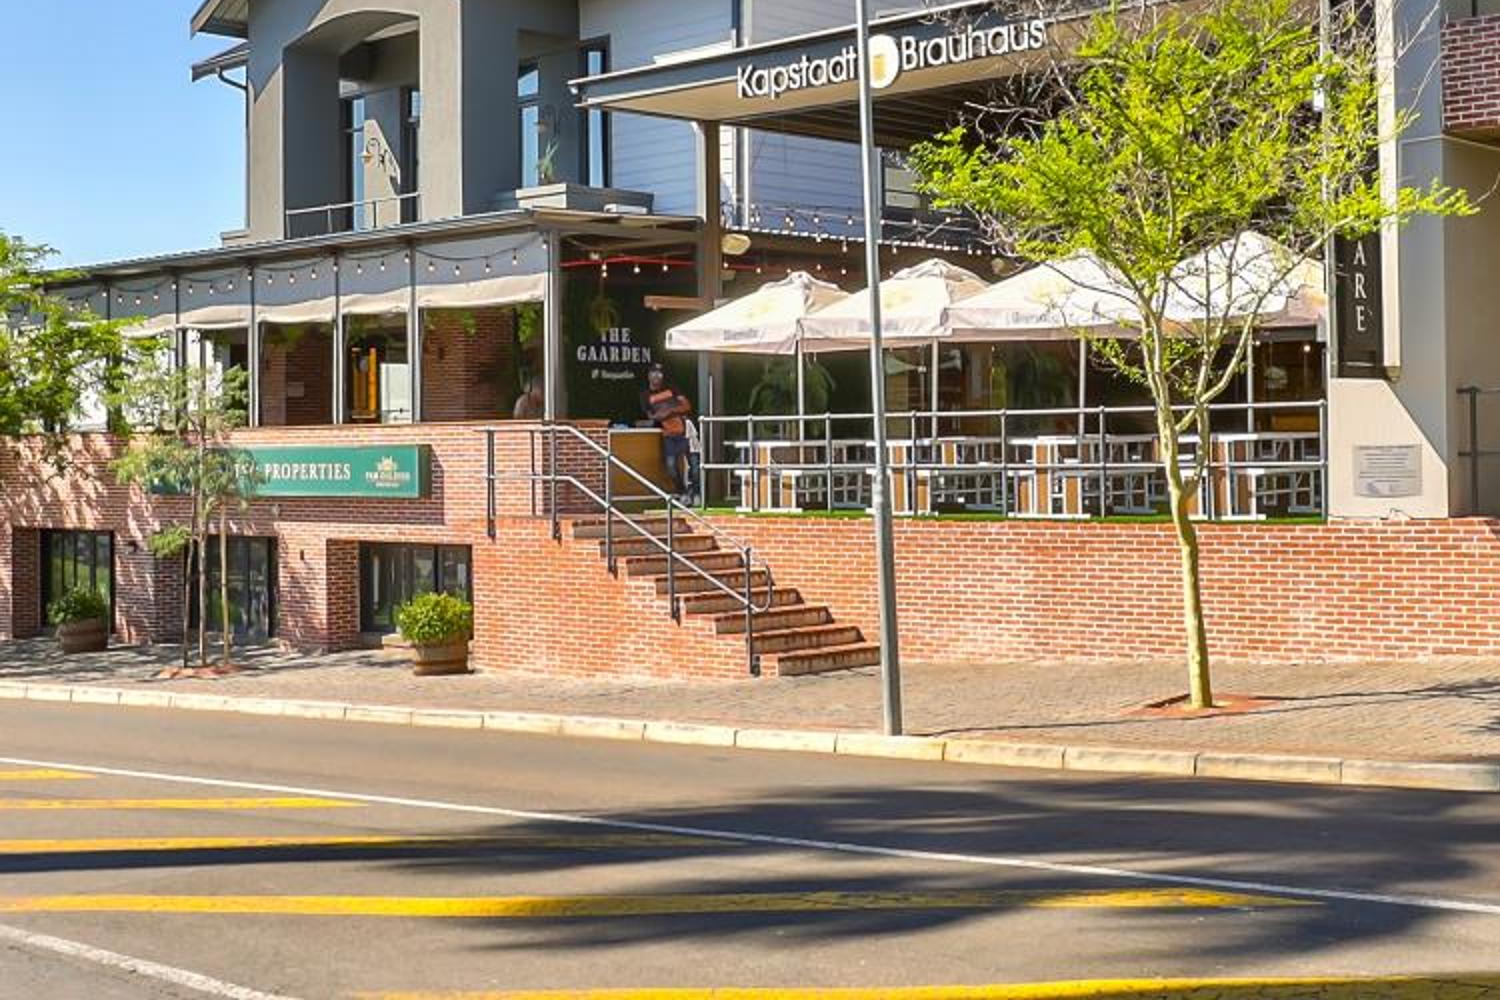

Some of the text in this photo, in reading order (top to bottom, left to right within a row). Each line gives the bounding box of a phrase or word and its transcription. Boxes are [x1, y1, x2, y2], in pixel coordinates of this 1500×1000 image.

[736, 18, 1048, 99] Kapstadt Brauhaus
[600, 327, 631, 343] THE
[576, 344, 652, 364] GAARDEN
[264, 461, 351, 481] PROPERTIES
